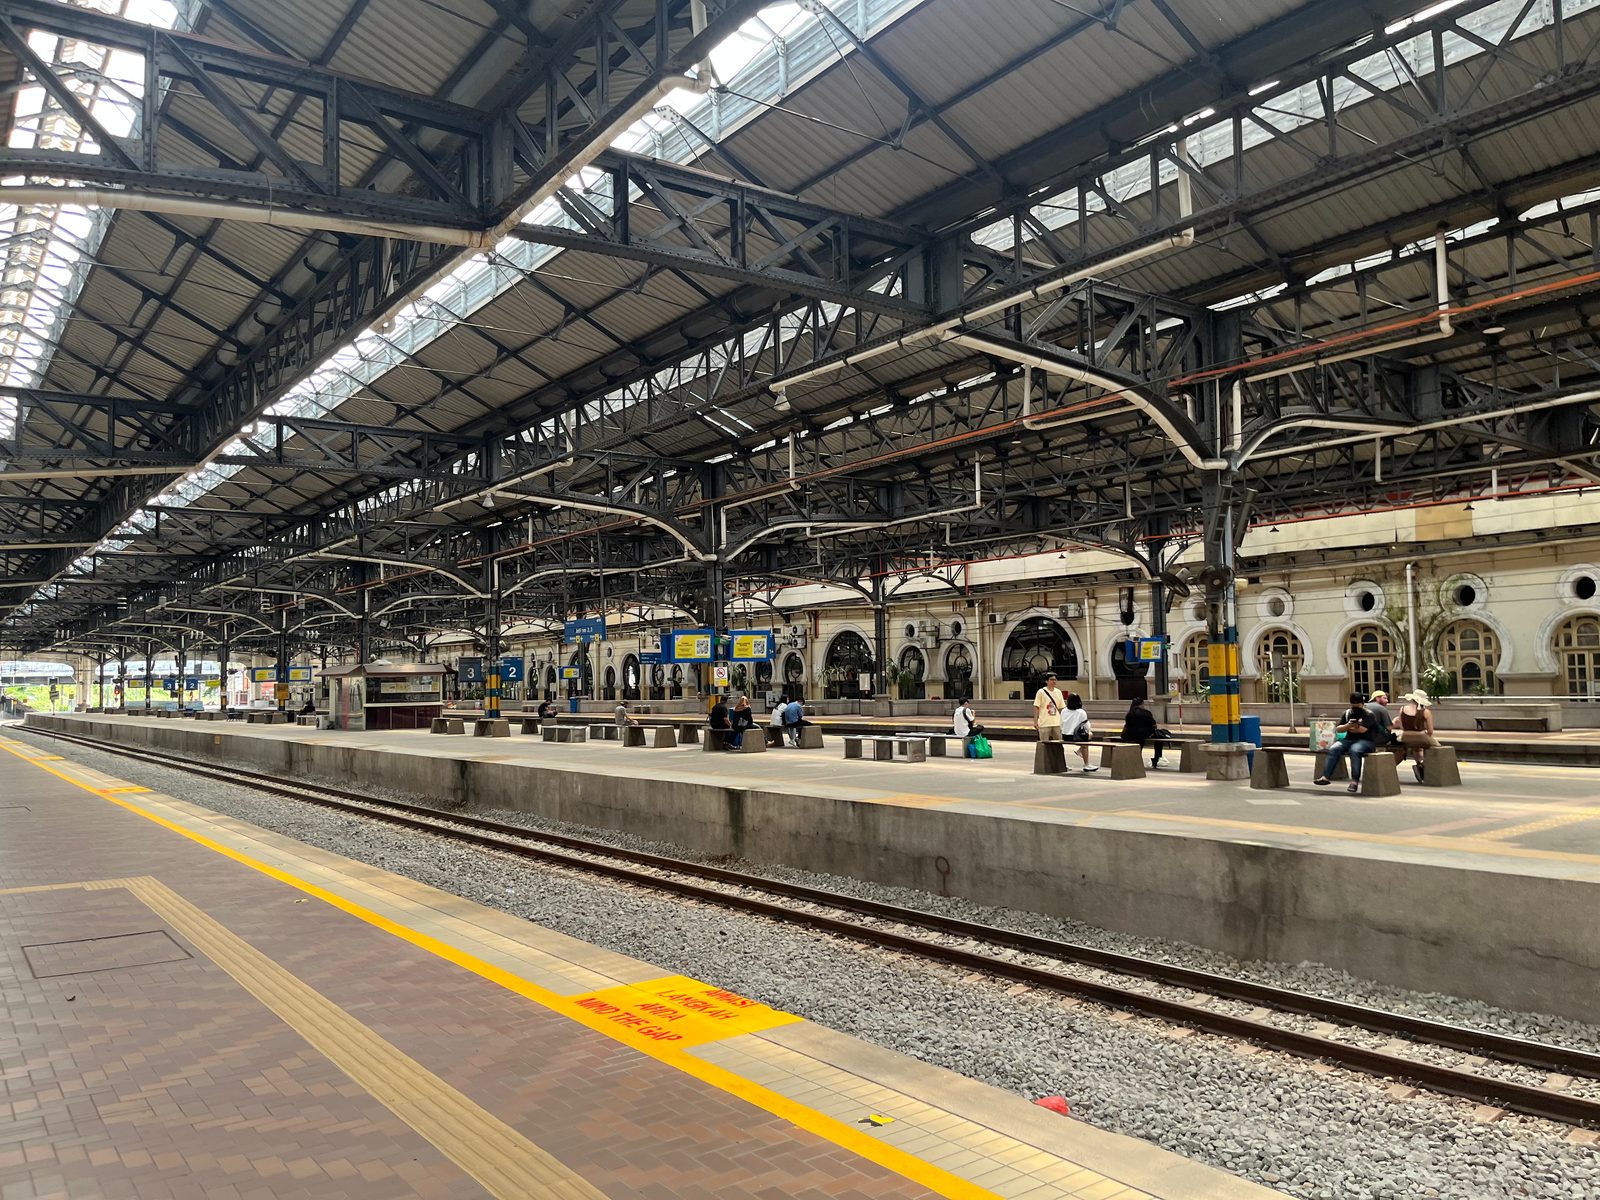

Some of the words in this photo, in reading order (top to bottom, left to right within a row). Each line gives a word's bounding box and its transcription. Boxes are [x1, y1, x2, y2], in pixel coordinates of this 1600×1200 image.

[467, 667, 475, 679] 3
[508, 666, 517, 678] 2
[656, 990, 739, 1020] LANGKAH
[700, 989, 758, 1008] AWASI
[574, 997, 621, 1015] MIND
[608, 1012, 650, 1028] THE
[637, 1026, 683, 1041] GAP
[634, 1003, 687, 1021] ANDA
